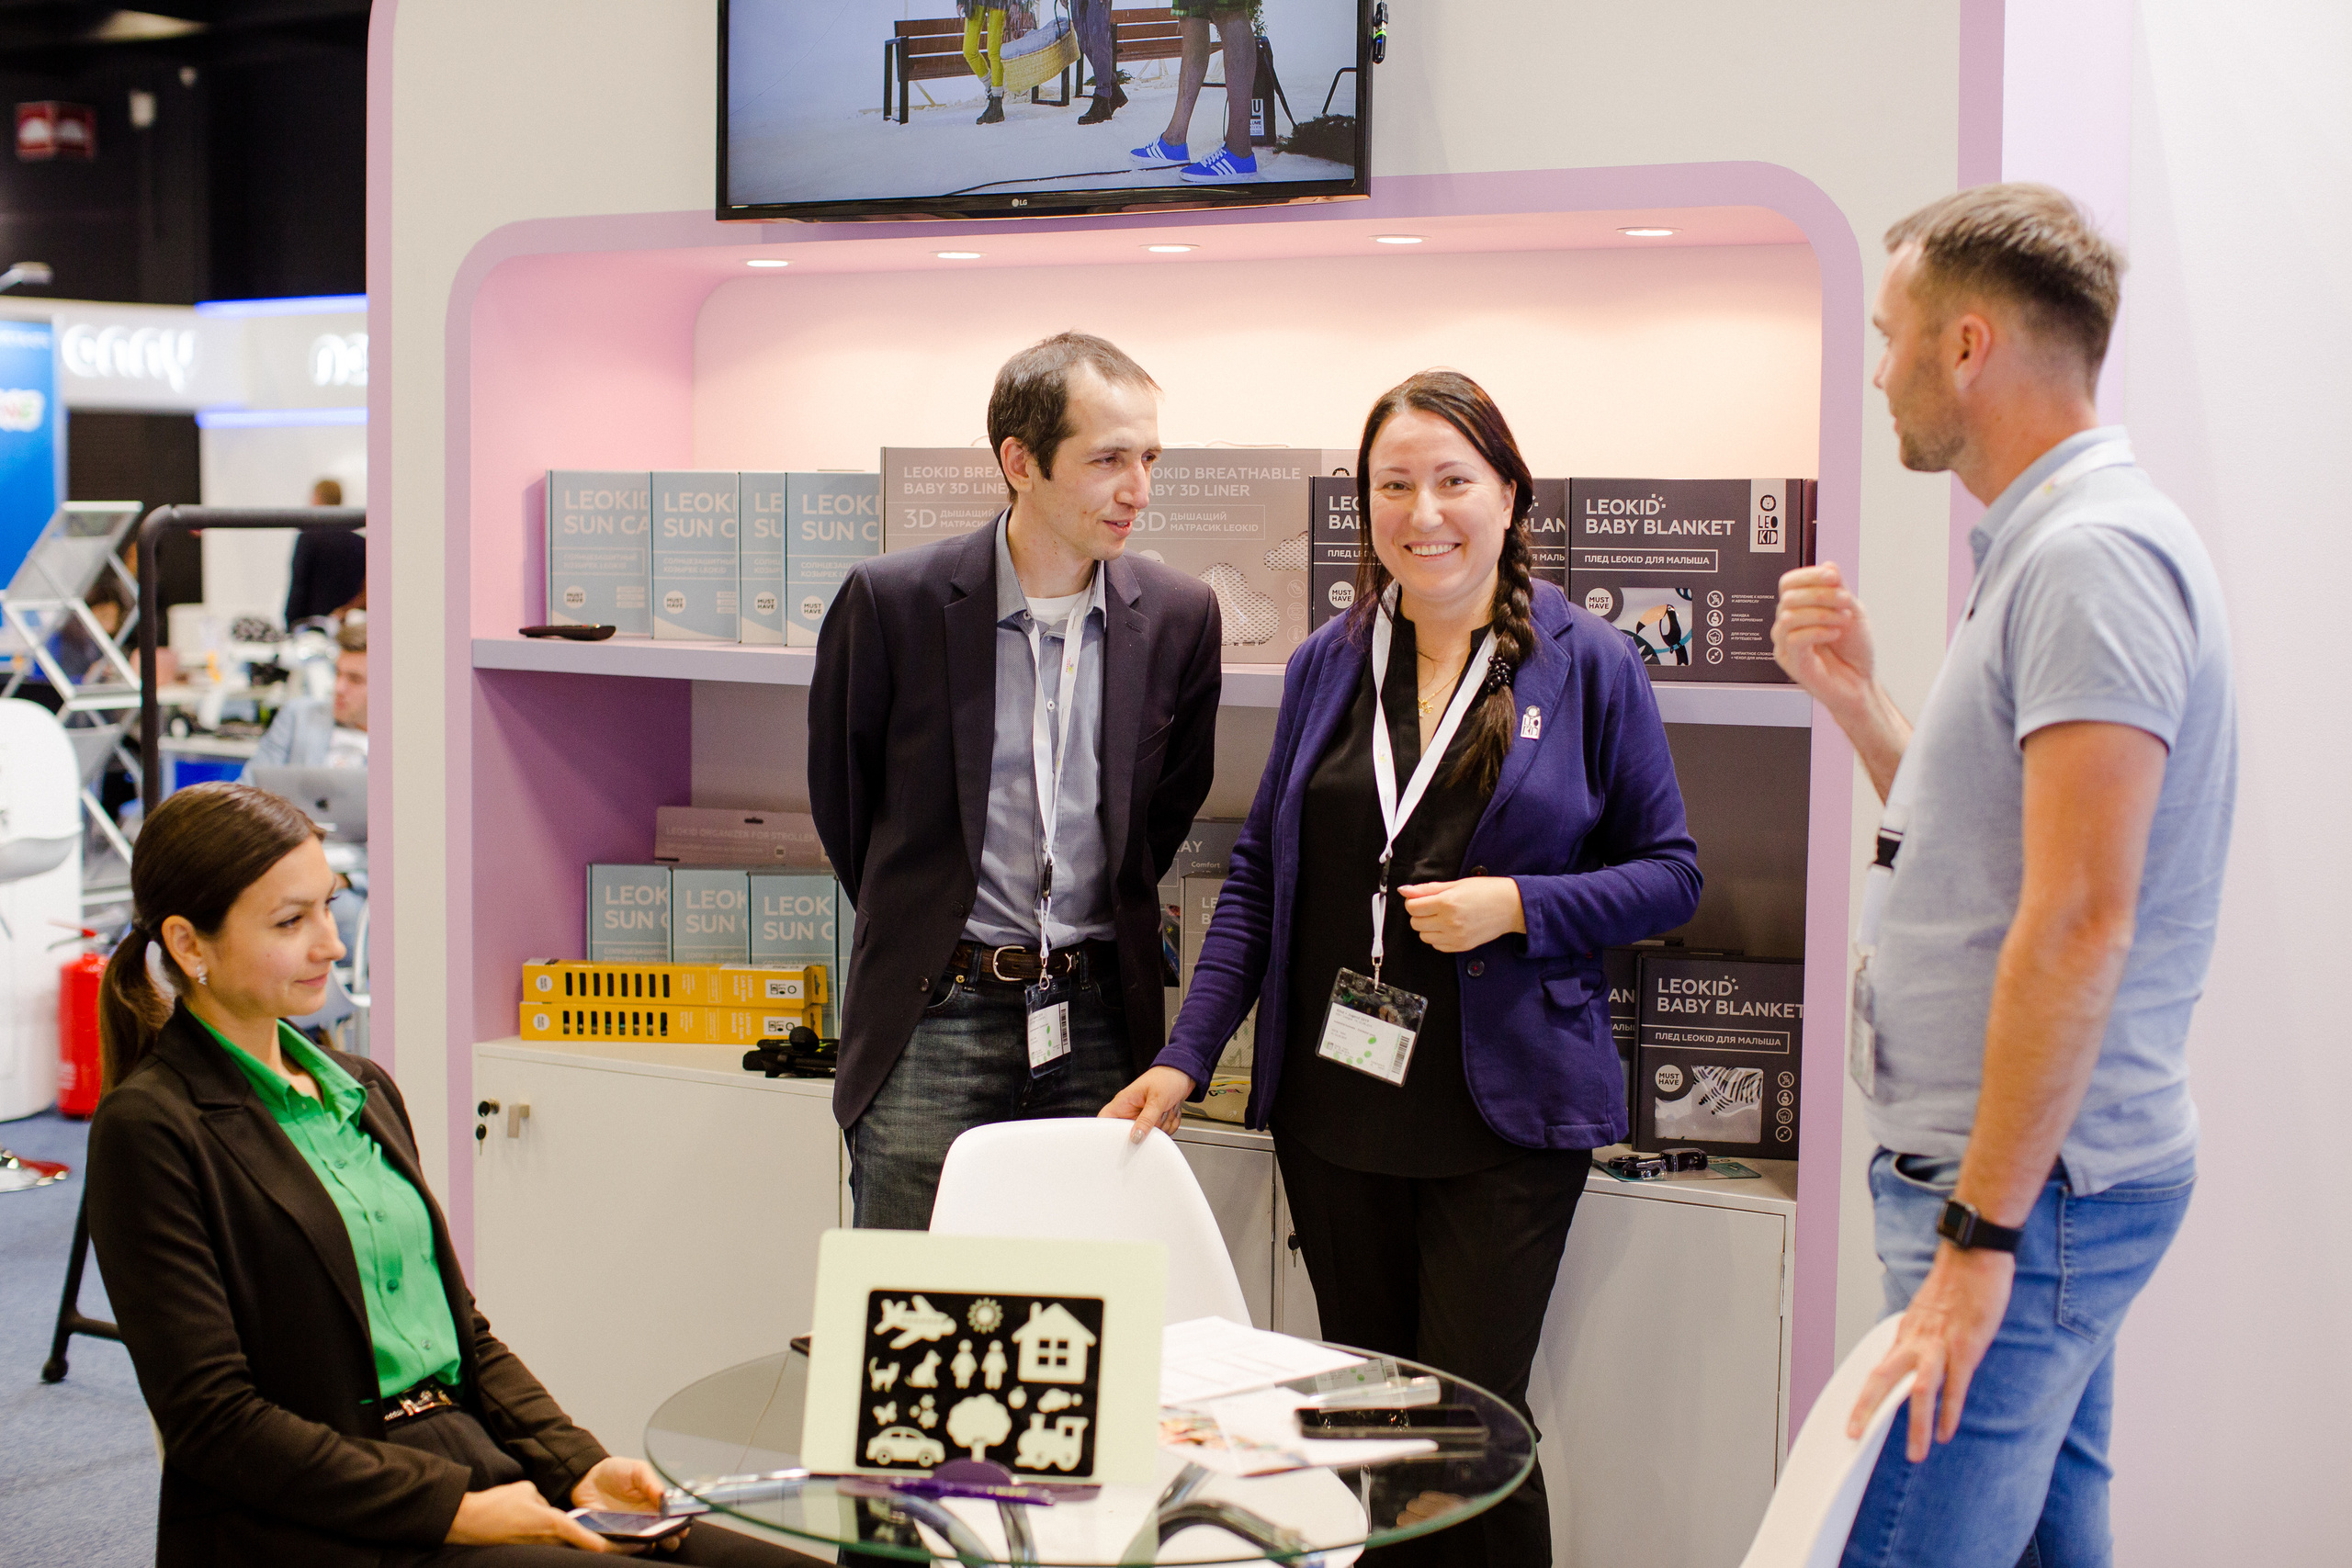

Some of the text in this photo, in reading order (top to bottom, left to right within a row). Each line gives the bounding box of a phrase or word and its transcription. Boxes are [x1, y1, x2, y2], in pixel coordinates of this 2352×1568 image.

[904, 467, 960, 479] LEOKID
[1151, 467, 1301, 479] OKID BREATHABLE
[904, 483, 1010, 495] BABY 3D LINE
[1180, 484, 1200, 497] 3D
[1204, 485, 1250, 497] LINER
[940, 509, 995, 518] ДЫШАЩИЙ
[1586, 499, 1660, 515] LEOKID
[903, 509, 937, 528] 3D
[1132, 512, 1167, 532] 3D
[1170, 512, 1227, 522] ДЫШАЩИЙ
[563, 515, 614, 535] SUN
[663, 518, 713, 538] SUN
[801, 520, 854, 542] SUN
[1170, 524, 1221, 532] МАТРАСИК
[1586, 519, 1736, 536] BABY BLANKET
[1758, 530, 1778, 545] KID
[1328, 549, 1351, 559] ПЛЕД
[1584, 555, 1710, 565] ПЛЕД LEOKID ДЛЯ МАЛЫША
[1177, 840, 1203, 853] AY
[604, 910, 653, 931] SUN
[685, 915, 734, 935] SUN
[763, 921, 813, 942] SUN
[1657, 978, 1733, 997] LEOKID
[1657, 997, 1804, 1019] BABY BLANKET
[1656, 1032, 1680, 1042] ПЛЕД
[1682, 1034, 1714, 1043] LEOKID
[1738, 1036, 1781, 1045] МАЛЫША
